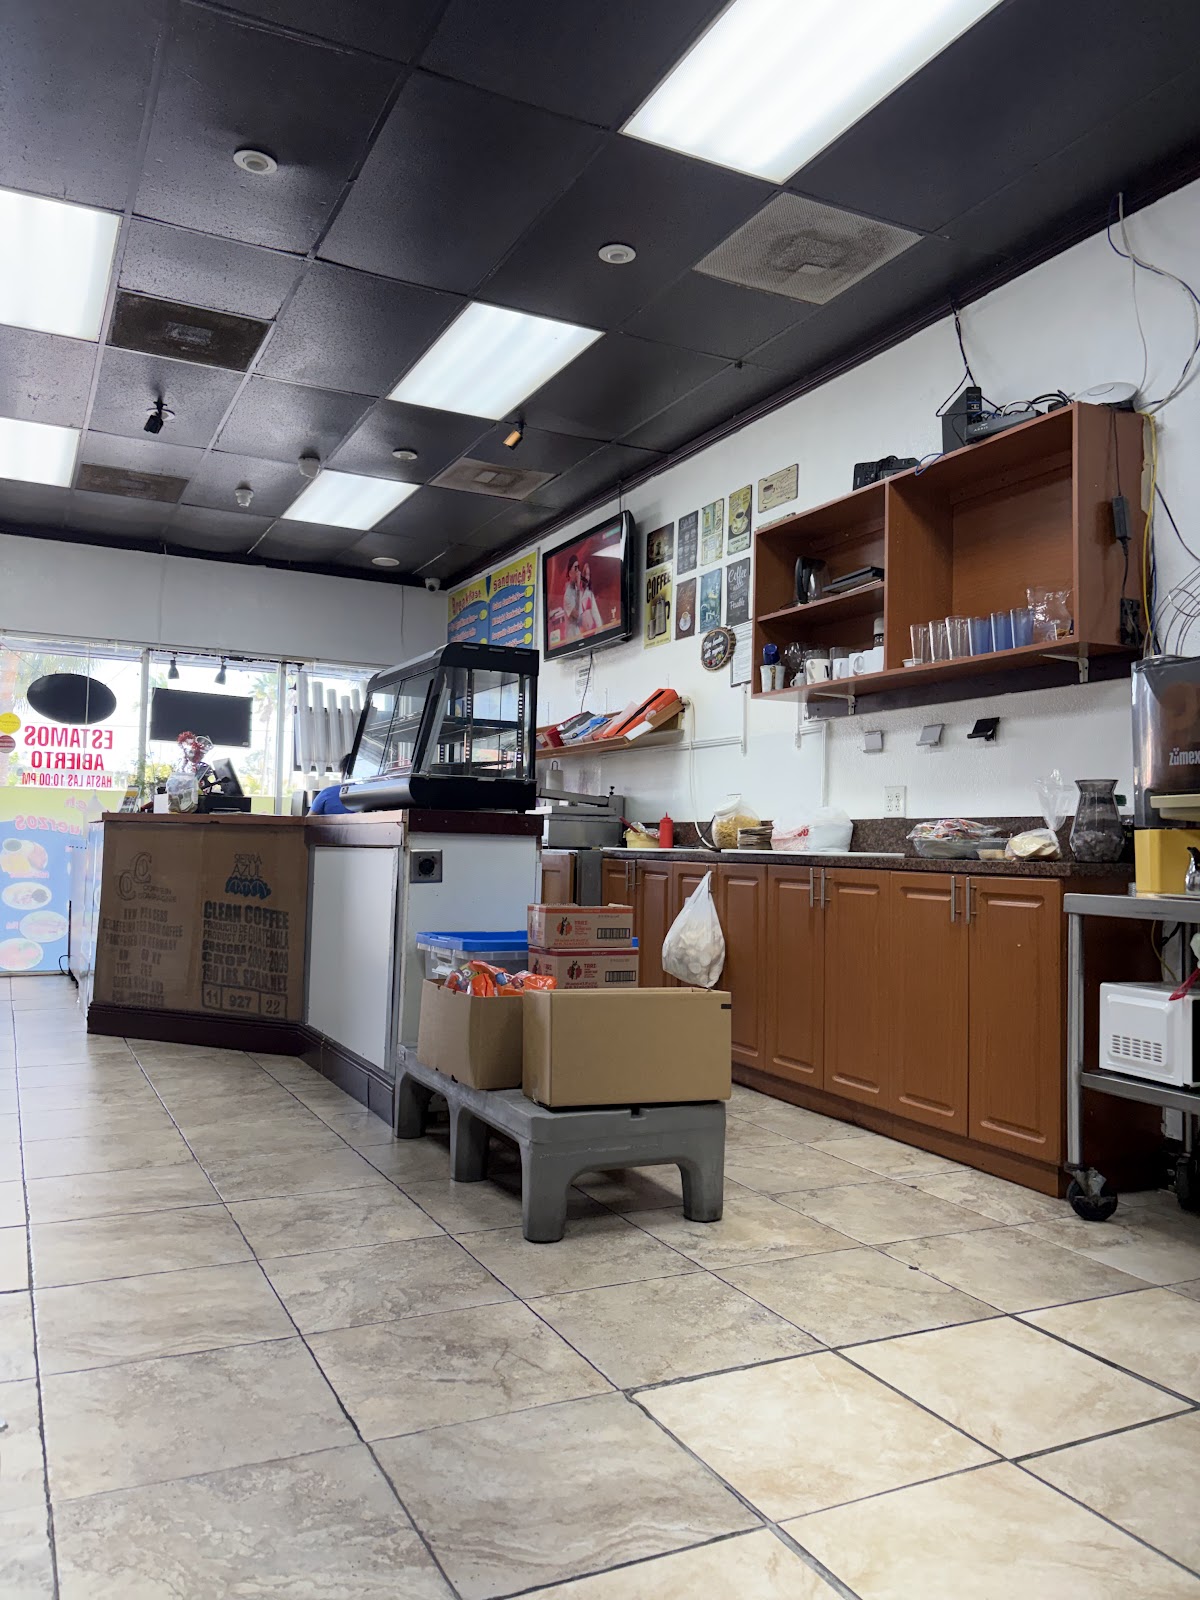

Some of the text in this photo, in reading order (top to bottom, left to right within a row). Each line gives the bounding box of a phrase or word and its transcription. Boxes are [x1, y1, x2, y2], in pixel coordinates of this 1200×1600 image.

[728, 565, 747, 583] Coffee
[647, 572, 671, 604] COFFEE
[231, 863, 263, 878] AZUL
[204, 900, 289, 930] CLEAN COFFEE
[204, 920, 248, 934] PRODUCTO DE
[203, 924, 289, 949] PRODUCT OF GUATEMALA
[203, 940, 246, 956] COSECHA
[202, 952, 247, 967] CROP
[206, 989, 281, 1014] 11 927 22
